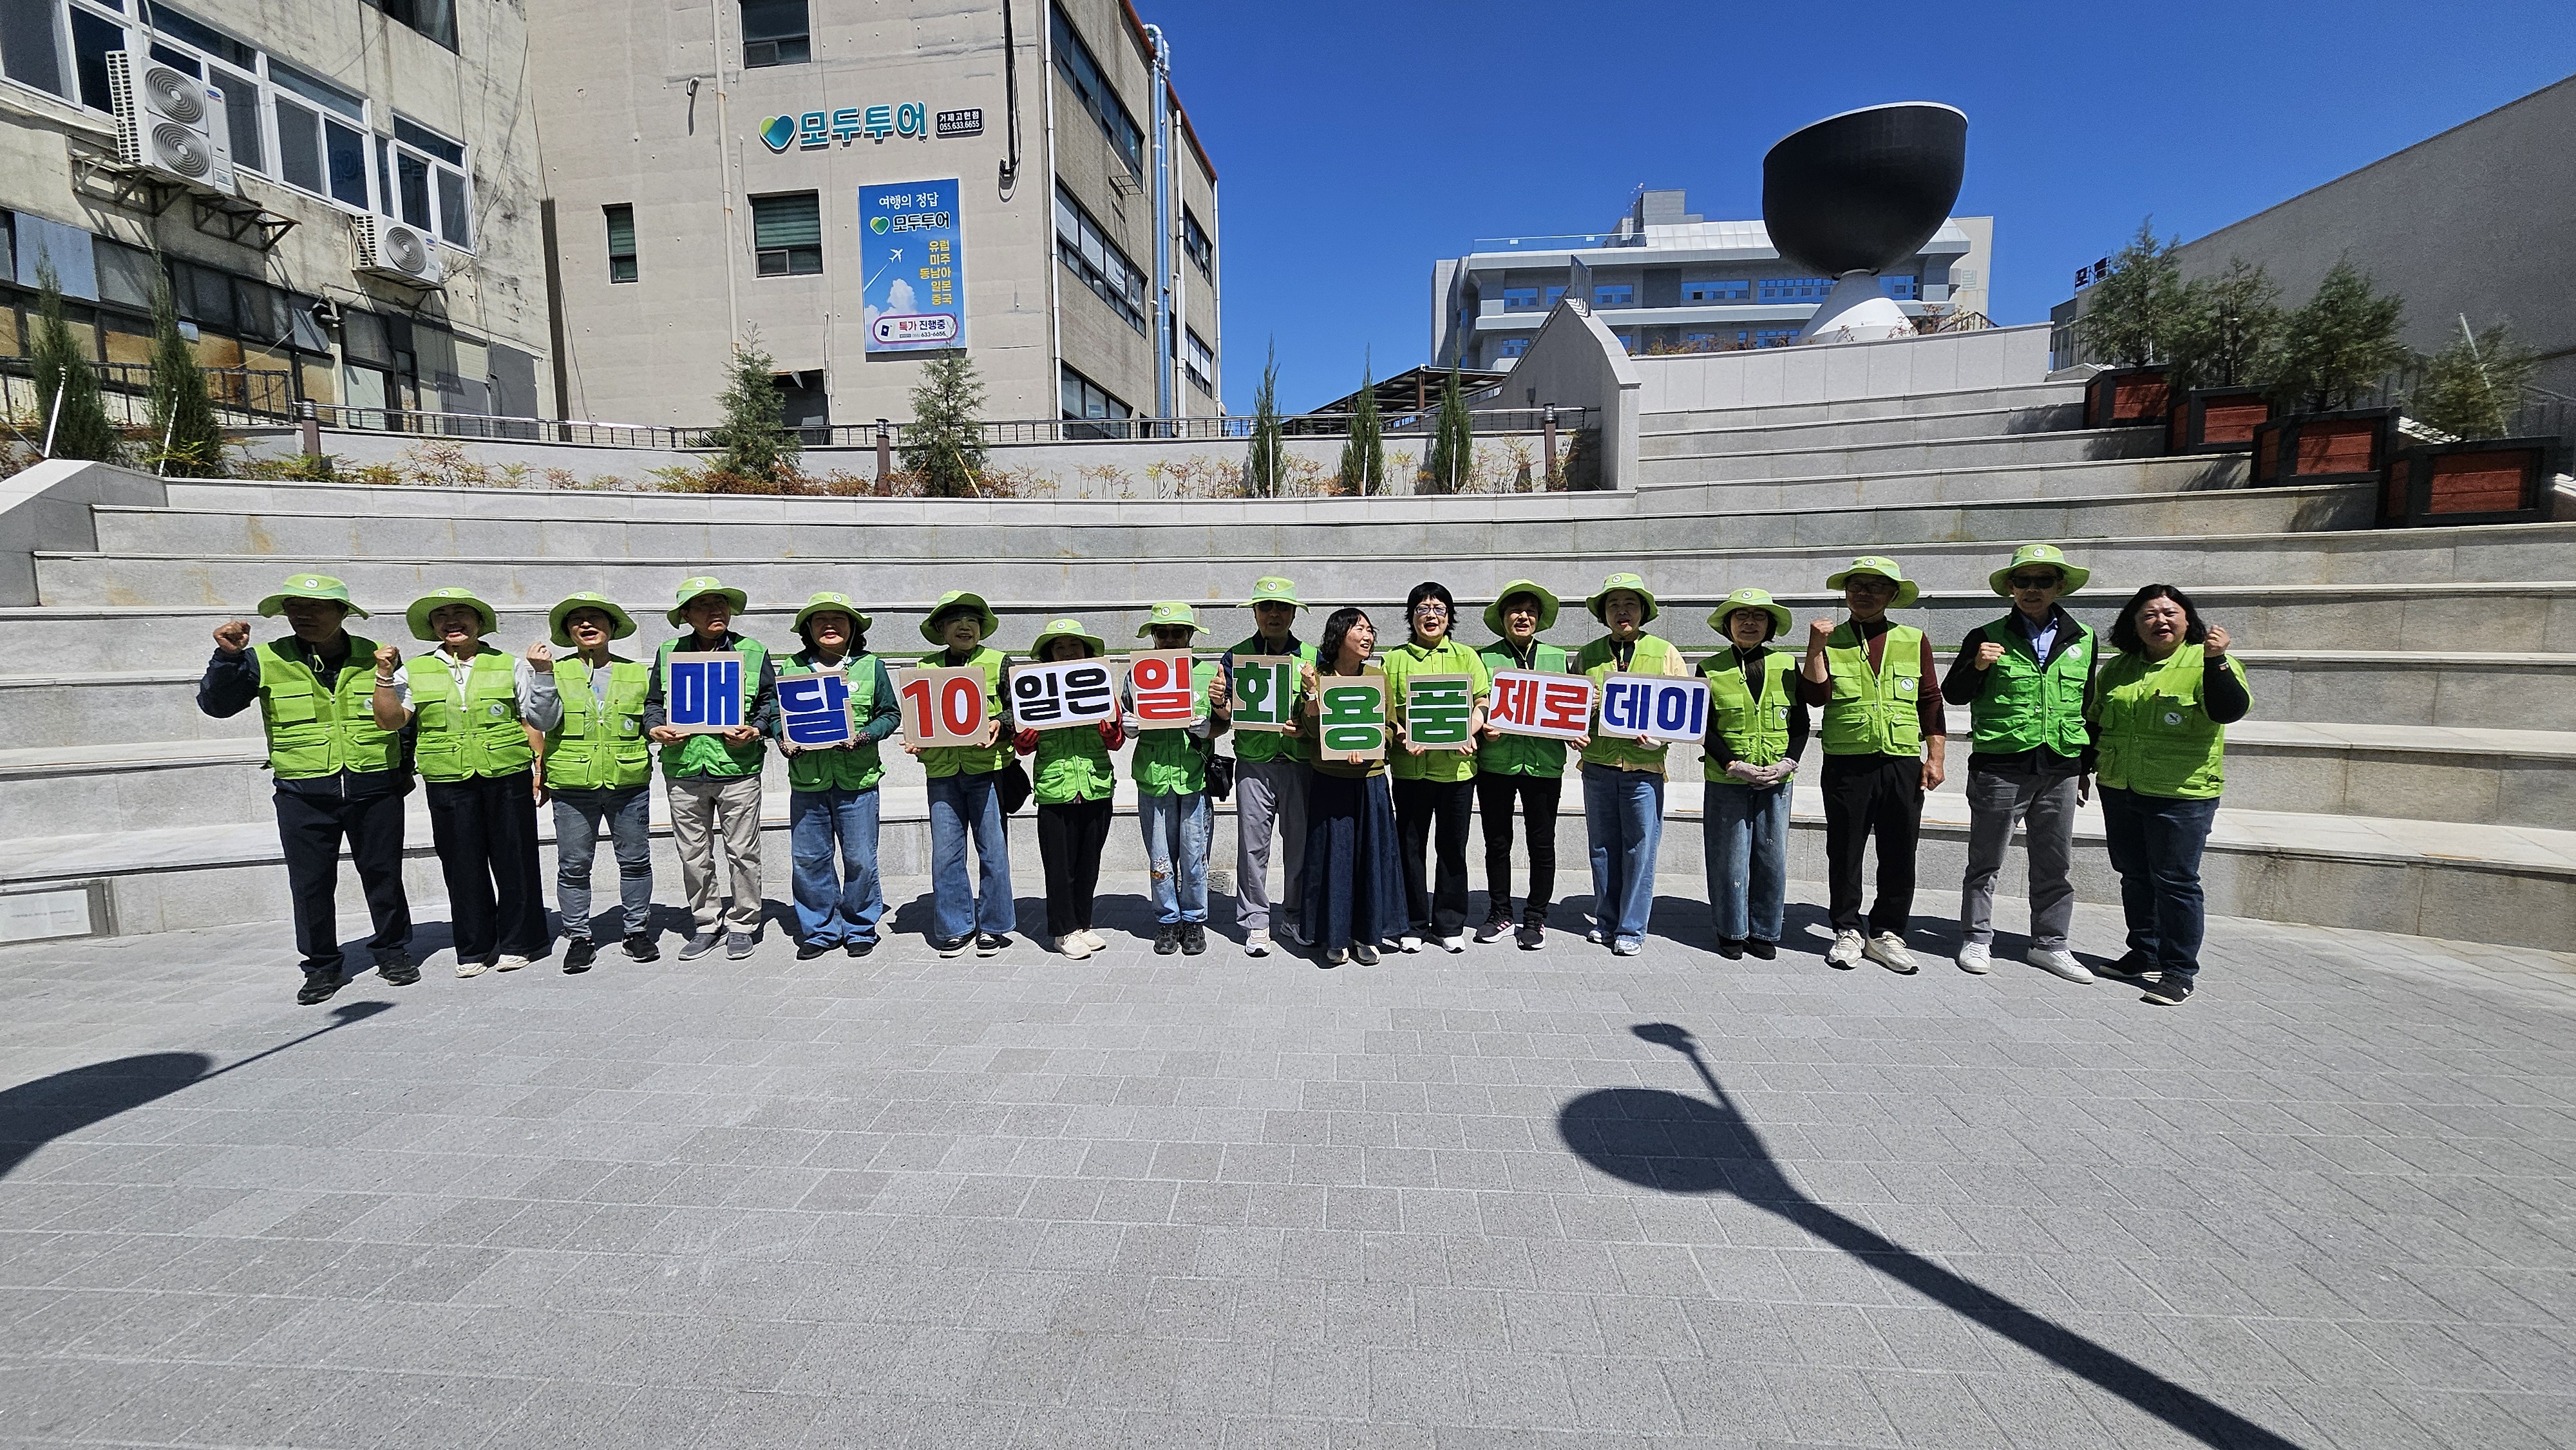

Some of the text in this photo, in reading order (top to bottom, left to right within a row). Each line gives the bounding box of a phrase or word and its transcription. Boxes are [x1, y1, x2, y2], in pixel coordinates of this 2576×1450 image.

[799, 101, 927, 147] 모두투어
[939, 120, 980, 131] 055.633.6655
[878, 192, 939, 210] 여행의 정답
[893, 211, 950, 233] 모두투어
[929, 240, 950, 252] 유럽
[930, 253, 951, 265] 미주
[920, 267, 951, 279] 동남아
[931, 279, 952, 292] 일본
[931, 293, 952, 305] 중국
[899, 319, 946, 332] 특가 진행중
[670, 661, 741, 726] 매
[777, 675, 851, 744] 달
[901, 677, 982, 739] 10
[1014, 668, 1111, 721] 일은
[1133, 657, 1192, 720] 일
[1233, 661, 1291, 723] 회
[1408, 680, 1470, 744] 품
[1490, 677, 1588, 732] 제로
[1604, 683, 1705, 734] 데이
[1321, 685, 1385, 751] 용
